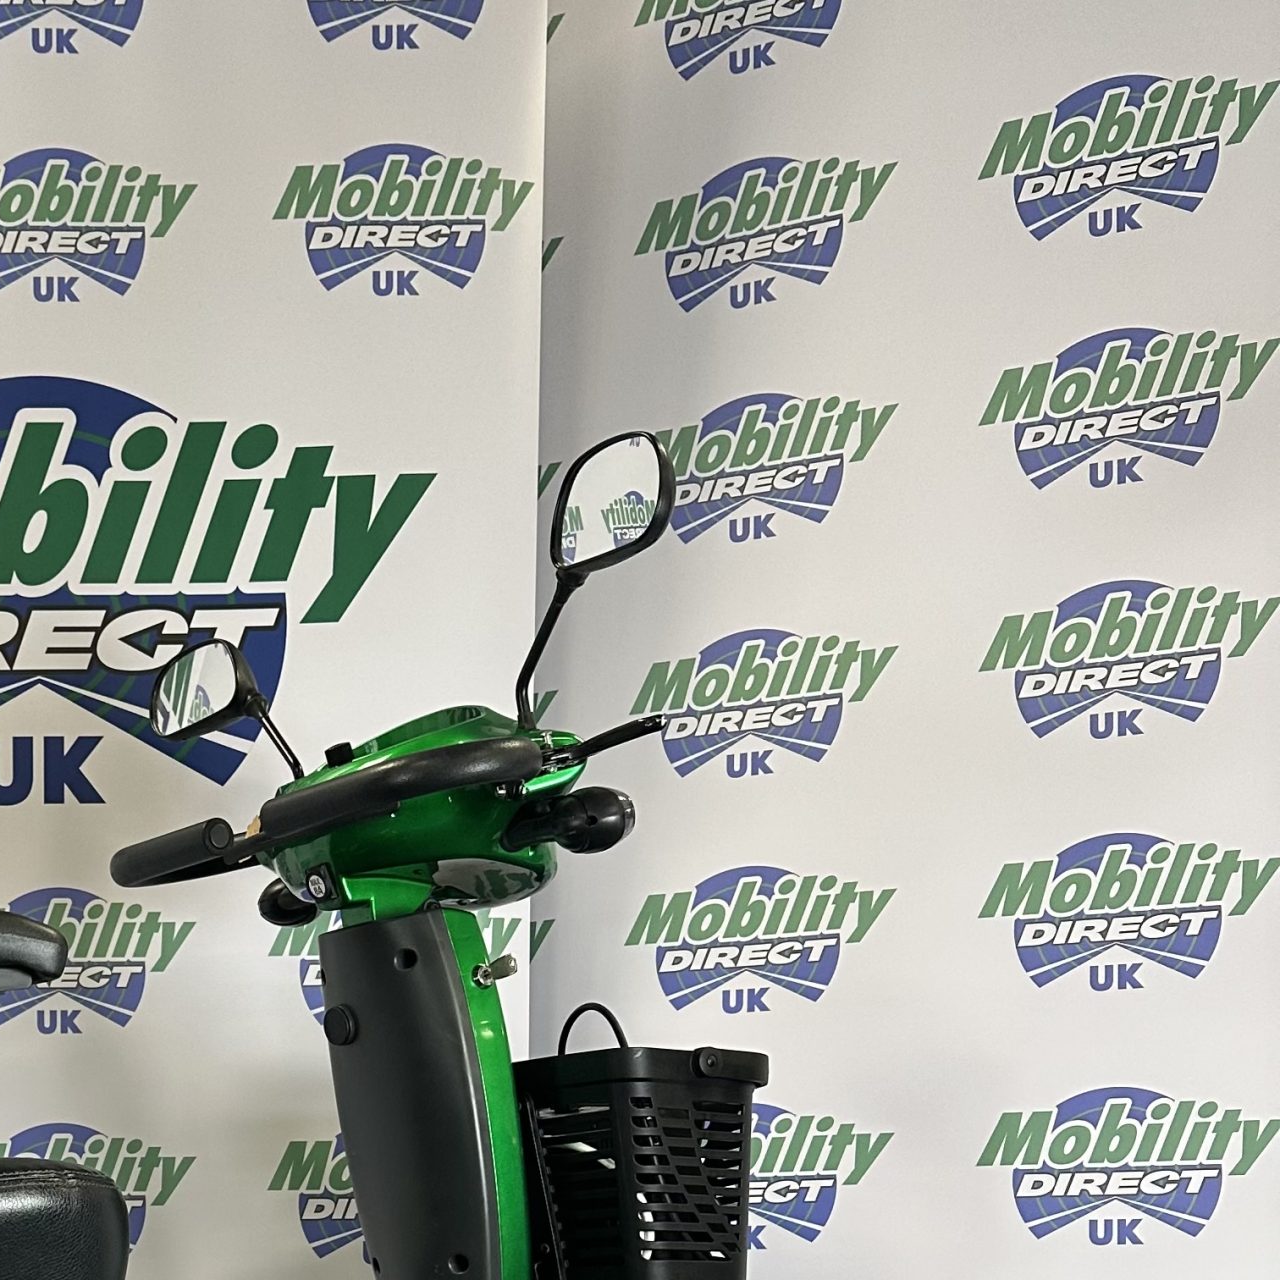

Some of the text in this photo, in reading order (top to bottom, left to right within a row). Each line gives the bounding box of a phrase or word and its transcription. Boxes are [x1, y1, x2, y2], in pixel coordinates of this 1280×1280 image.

[31, 28, 80, 55] UK
[372, 23, 420, 51] UK
[728, 42, 777, 75] UK
[978, 75, 1280, 180] Mobility
[1017, 142, 1216, 203] DIRECT
[272, 157, 535, 232] Mobility
[634, 157, 898, 256] Mobility
[308, 223, 483, 251] DIRECT
[1087, 204, 1142, 238] UK
[668, 220, 841, 278] DIRECT
[33, 275, 81, 303] UK
[372, 269, 420, 296] UK
[729, 276, 778, 309] UK
[978, 330, 1280, 427] Mobility
[655, 396, 899, 479] Mobility
[1018, 398, 1218, 451] DIRECT
[675, 462, 841, 508] DIRECT
[1089, 456, 1144, 488] UK
[728, 513, 778, 543] UK
[978, 586, 1280, 673] Mobility
[628, 635, 899, 716] Mobility
[1018, 655, 1218, 699] DIRECT
[665, 699, 841, 741] DIRECT
[1089, 709, 1144, 740] UK
[724, 749, 774, 778] UK
[977, 842, 1280, 919] Mobility
[624, 874, 898, 948] Mobility
[1016, 911, 1221, 946] DIRECT
[660, 938, 838, 972] DIRECT
[1089, 962, 1144, 991] UK
[721, 986, 771, 1014] UK
[36, 1010, 83, 1034] UK
[750, 1115, 895, 1186] ility
[976, 1100, 1280, 1177] Mobility
[1015, 1169, 1220, 1197] DIRECT
[746, 1225, 768, 1251] K
[1088, 1218, 1144, 1246] UK
